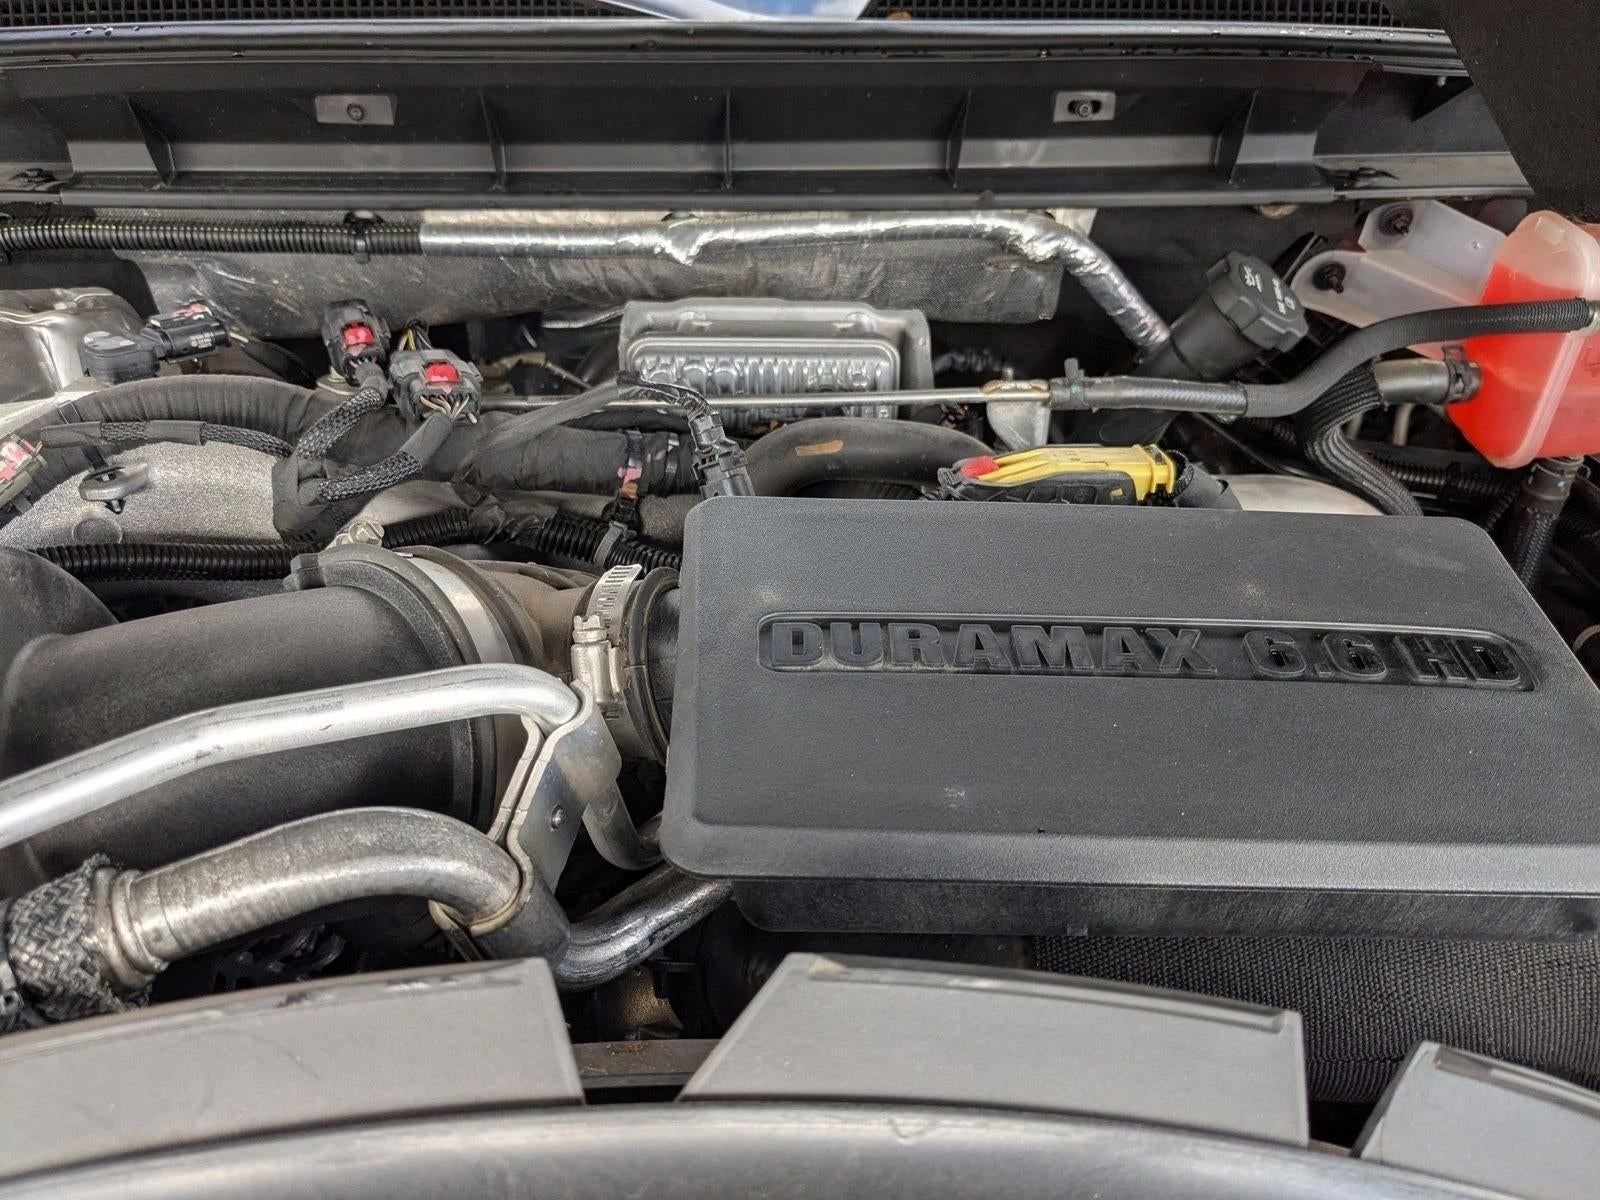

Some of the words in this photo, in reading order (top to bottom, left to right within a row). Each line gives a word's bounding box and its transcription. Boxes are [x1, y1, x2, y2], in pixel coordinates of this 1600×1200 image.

[771, 621, 1217, 673] DURAMAX
[1242, 629, 1388, 680] 6.6
[1393, 635, 1521, 684] HD
